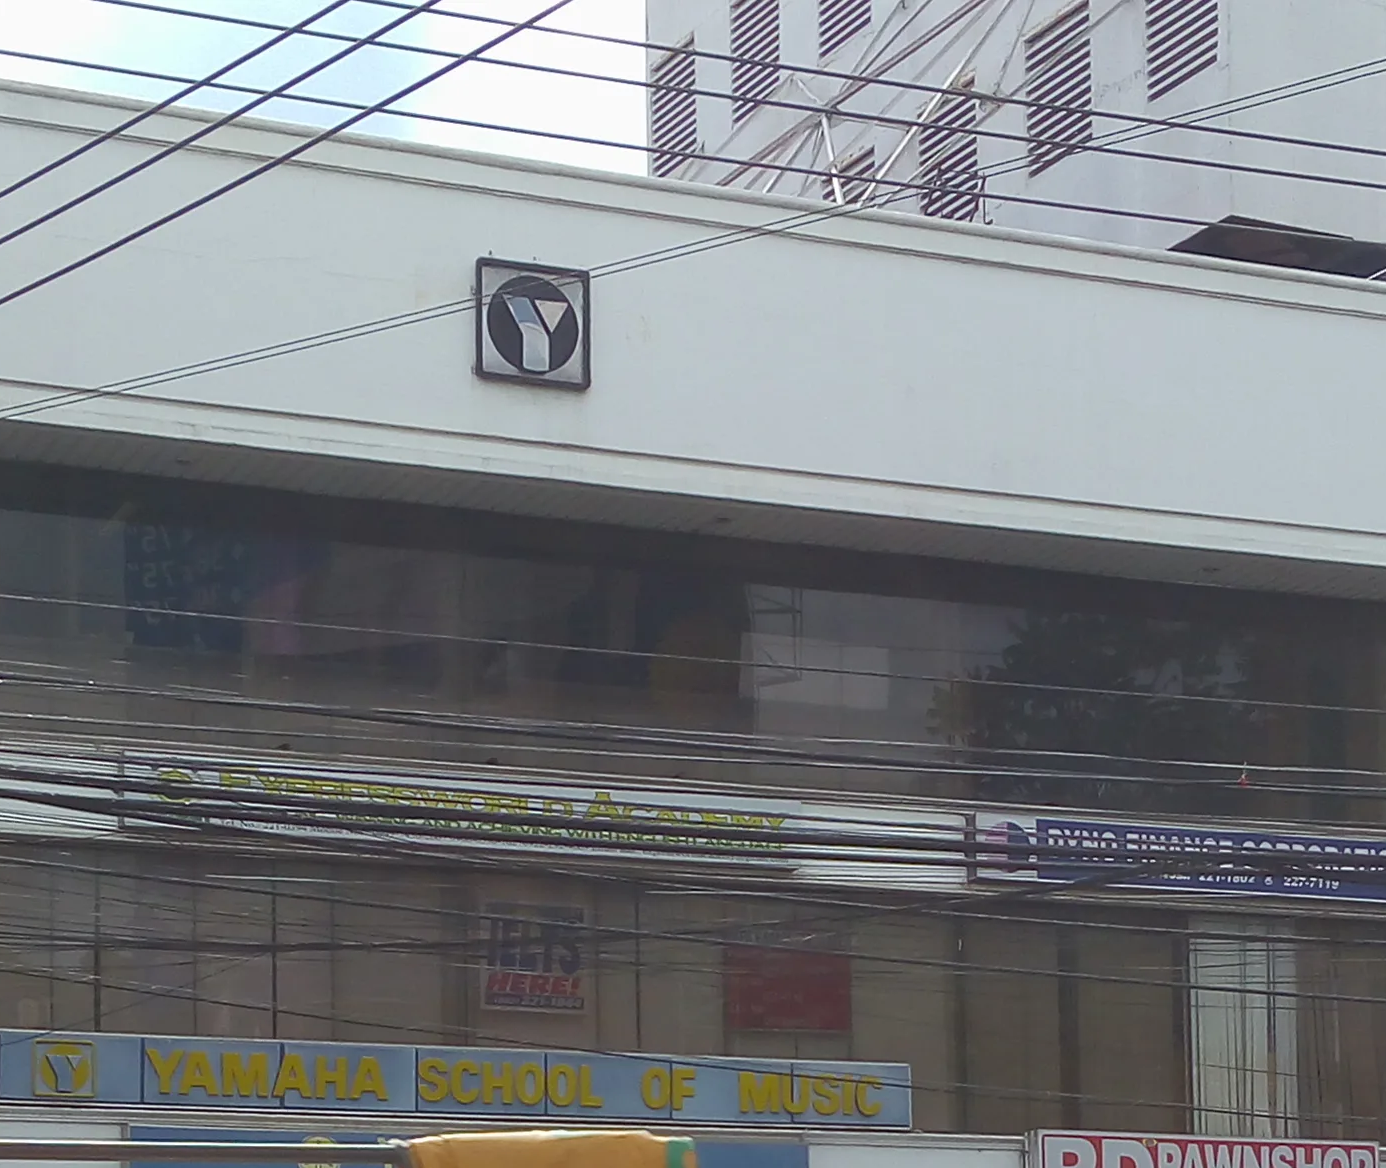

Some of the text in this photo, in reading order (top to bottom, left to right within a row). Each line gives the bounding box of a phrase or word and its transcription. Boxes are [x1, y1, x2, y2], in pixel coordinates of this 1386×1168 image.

[486, 971, 581, 998] HERE!
[144, 1048, 883, 1118] YAMAHA SCHOOL OF MUSIC
